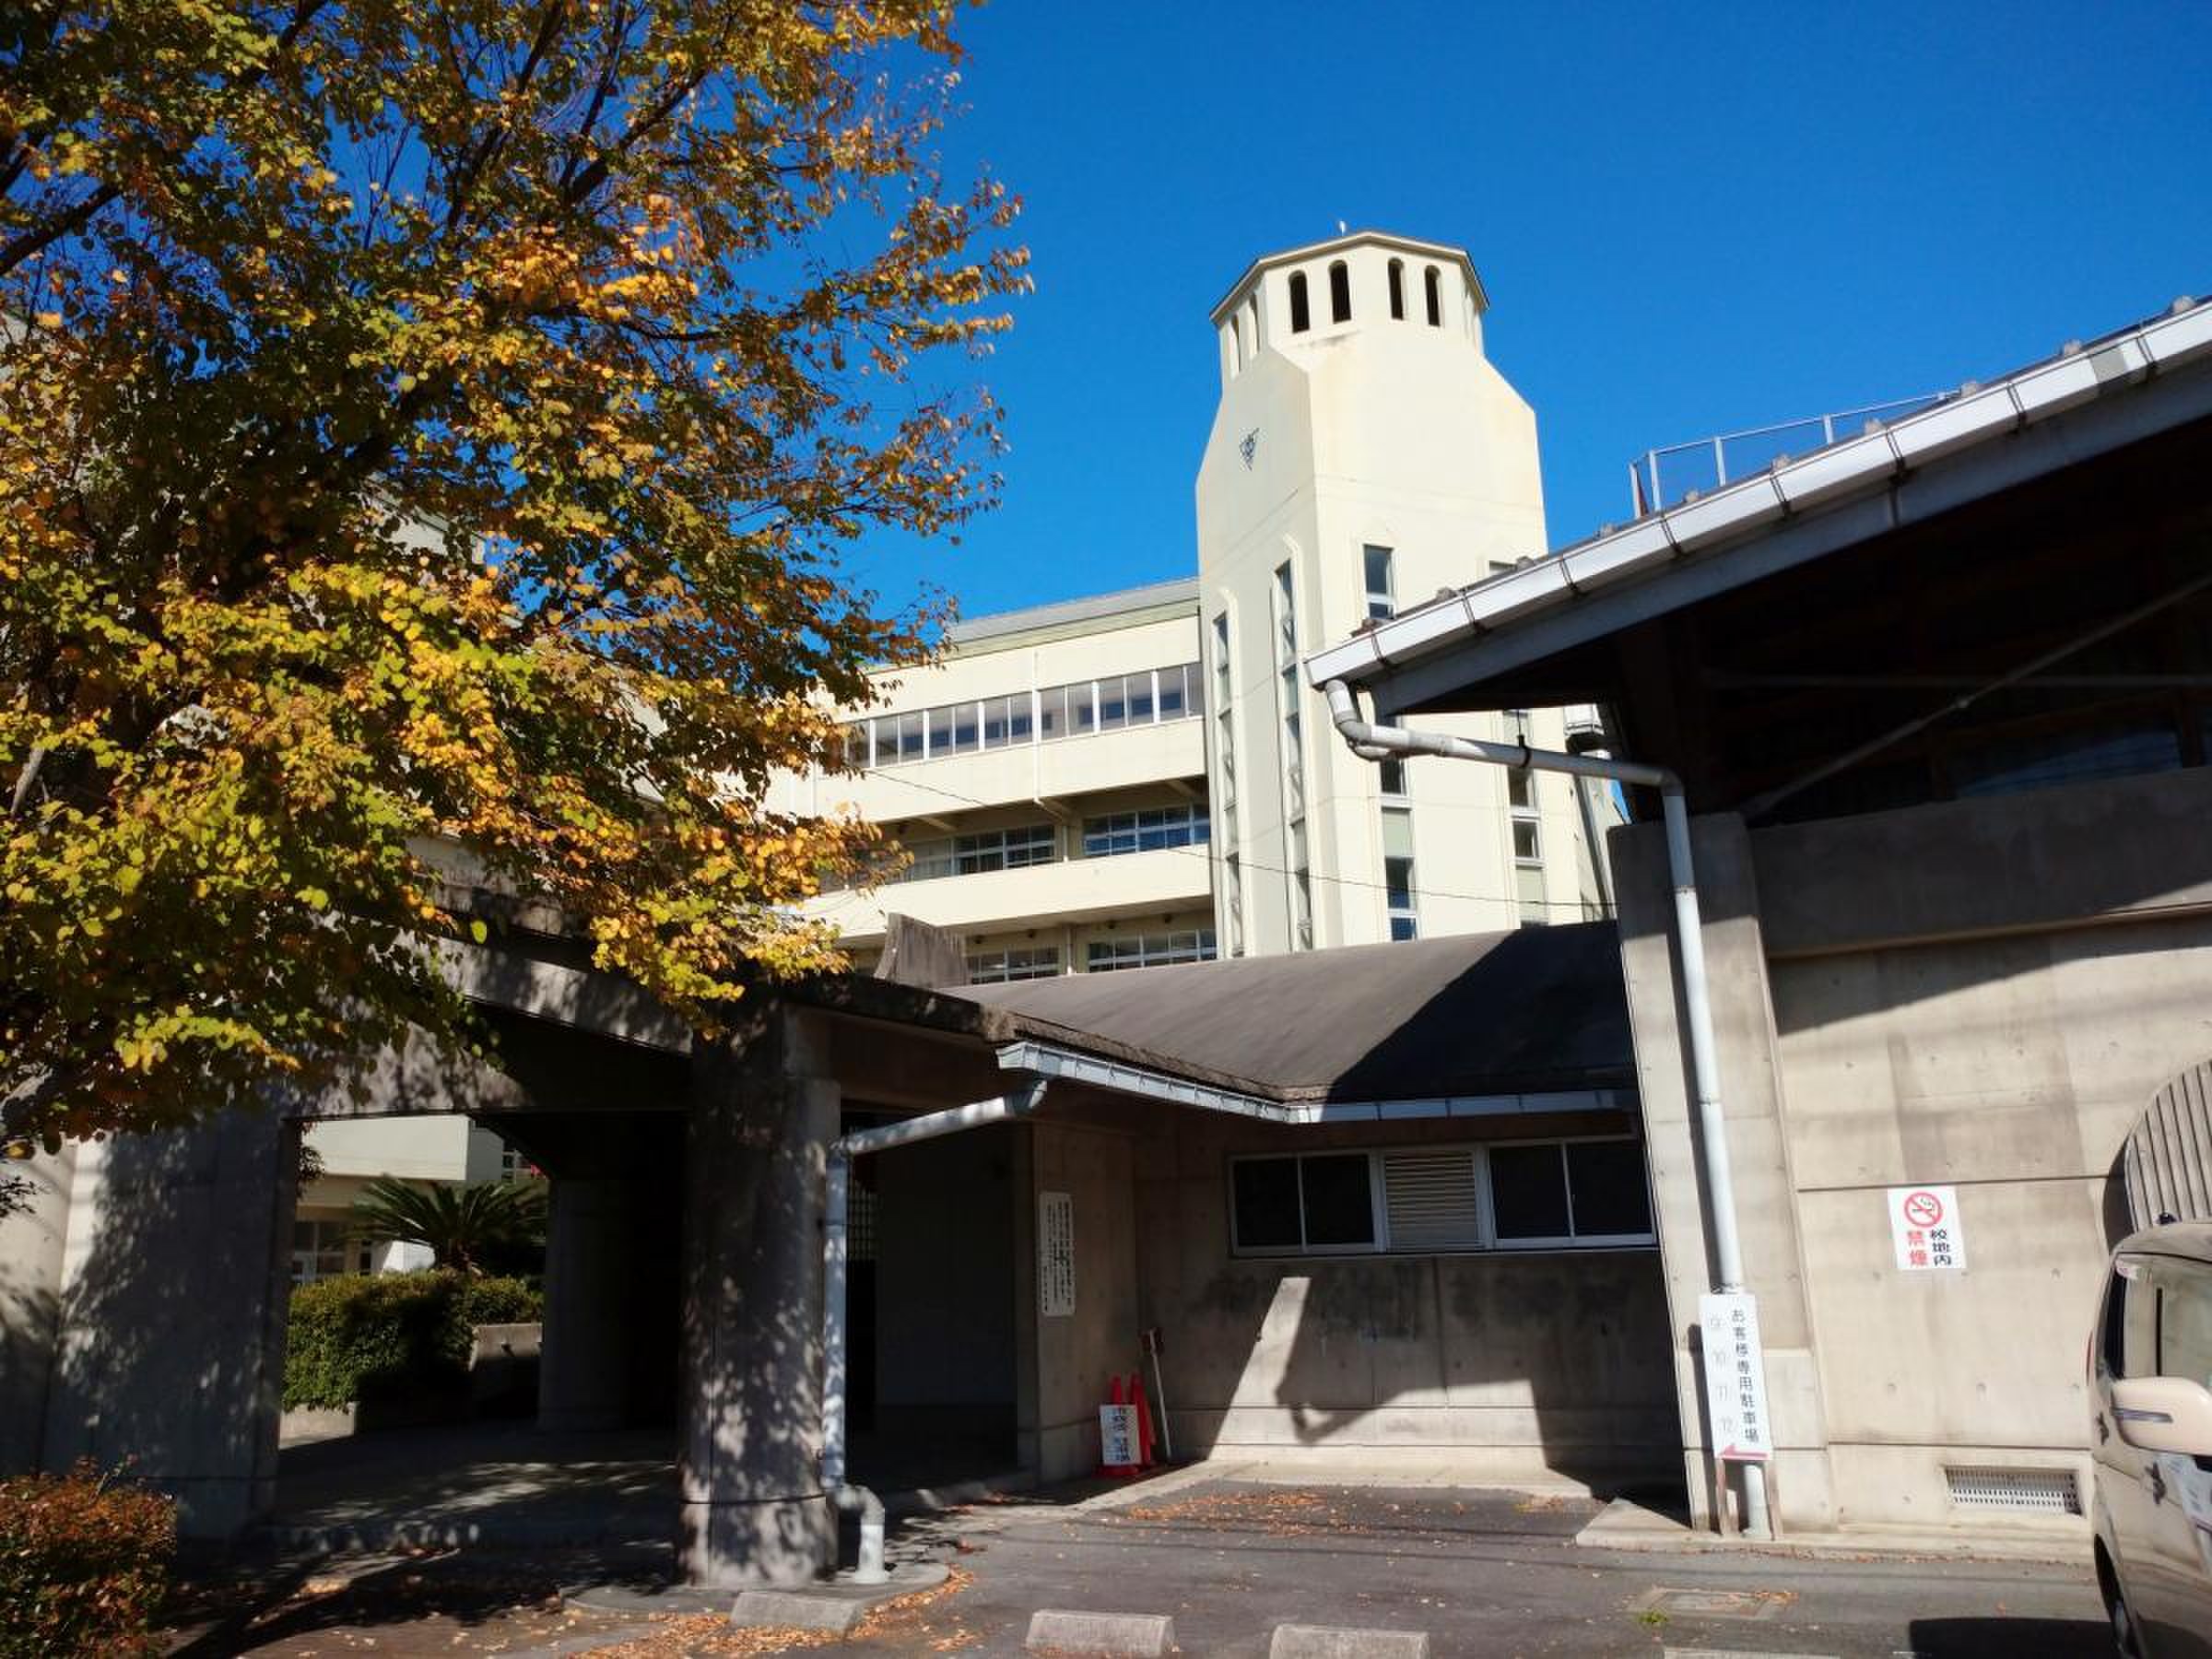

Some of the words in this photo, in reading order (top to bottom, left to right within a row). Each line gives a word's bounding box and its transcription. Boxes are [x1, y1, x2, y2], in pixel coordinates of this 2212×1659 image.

[1907, 1230, 1927, 1266] 禁煙
[1930, 1229, 1951, 1266] 校地内
[1732, 1309, 1759, 1442] お客様専用駐車場
